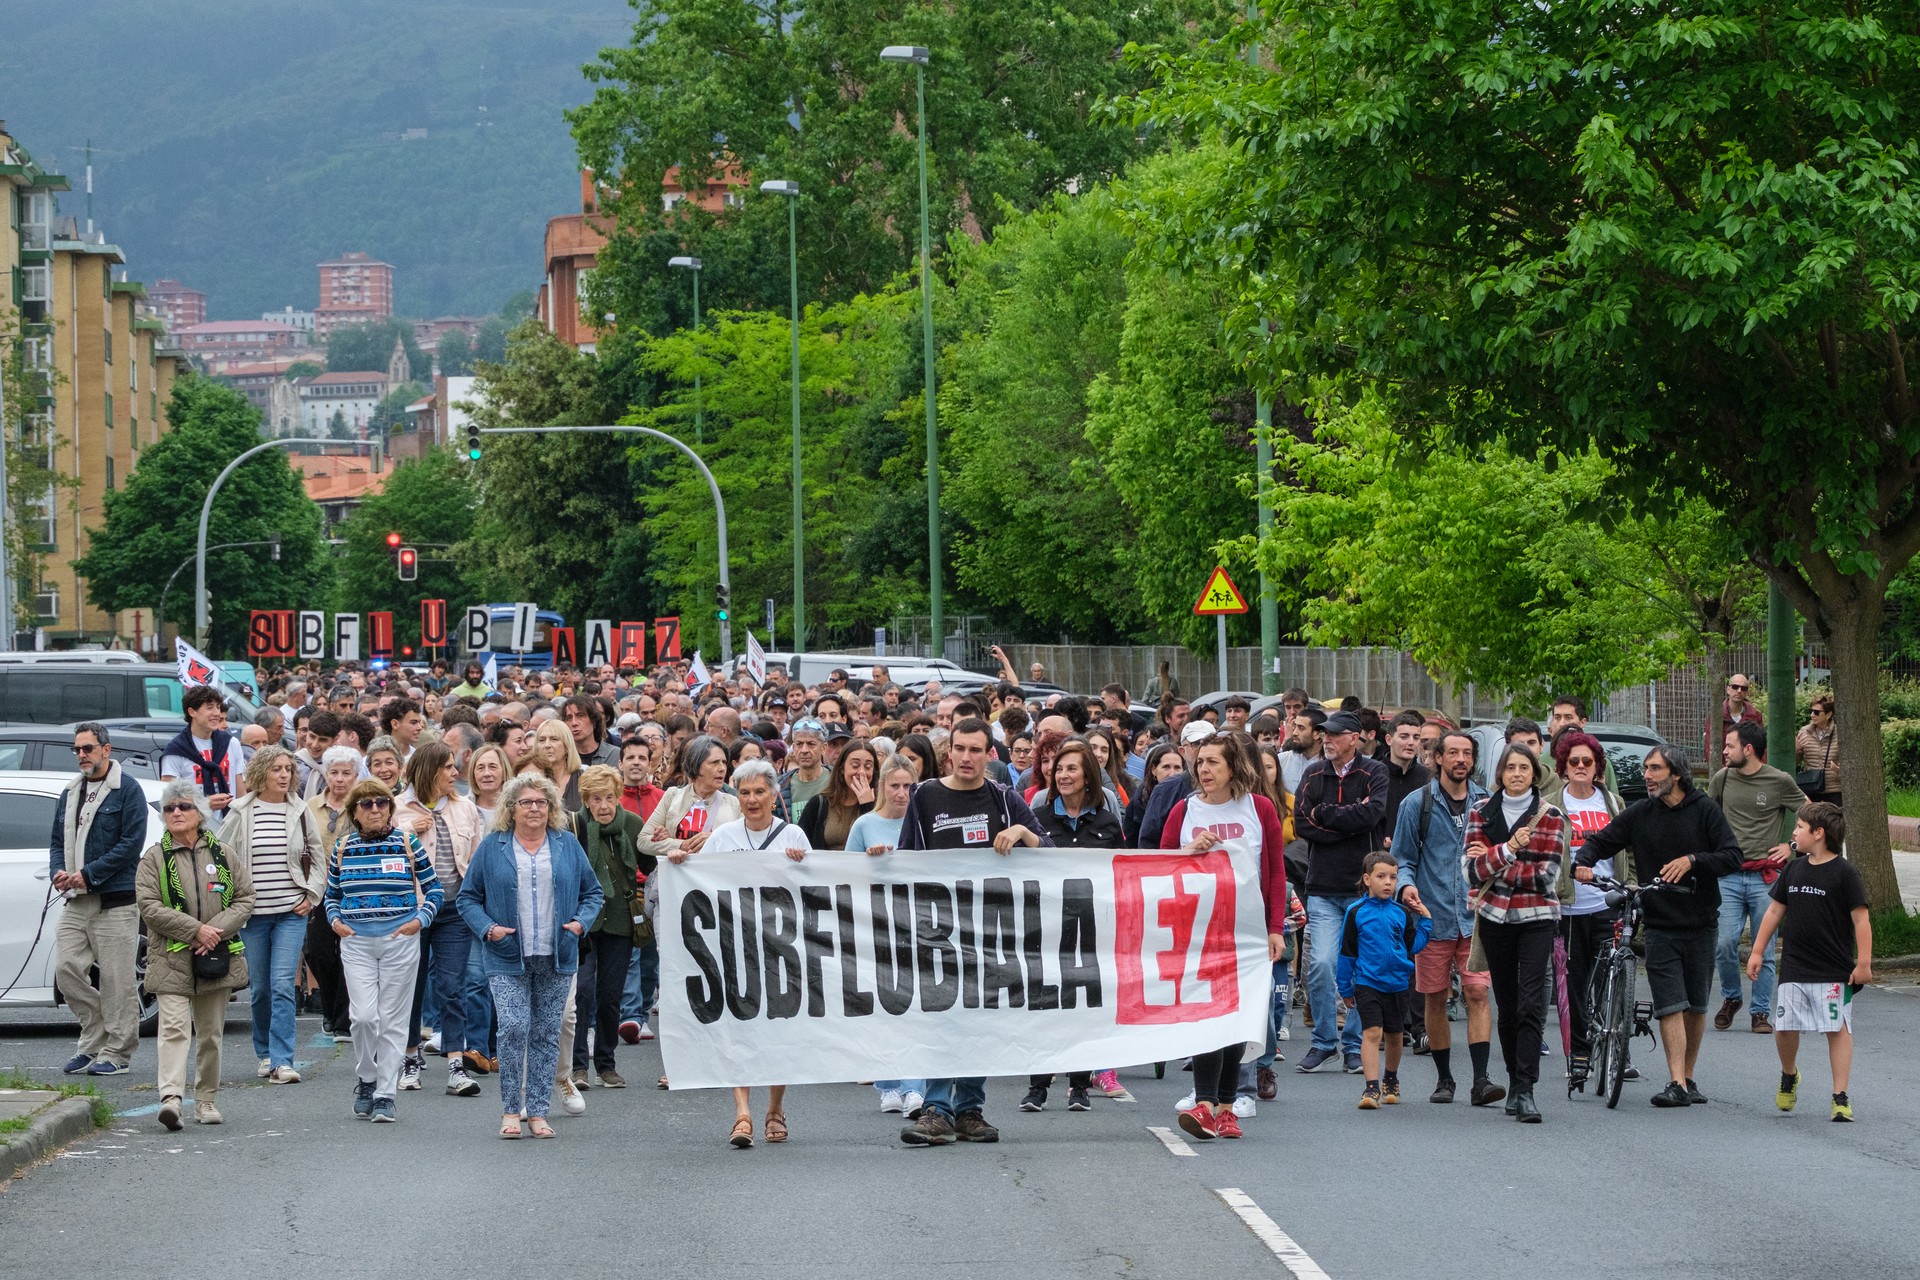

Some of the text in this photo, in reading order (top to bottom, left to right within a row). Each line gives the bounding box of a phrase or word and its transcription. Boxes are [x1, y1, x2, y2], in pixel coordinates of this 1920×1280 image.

[1800, 886, 1826, 896] filtro
[681, 873, 1216, 1024] SUBFLUBIALA EZ
[1829, 1003, 1838, 1020] 5
